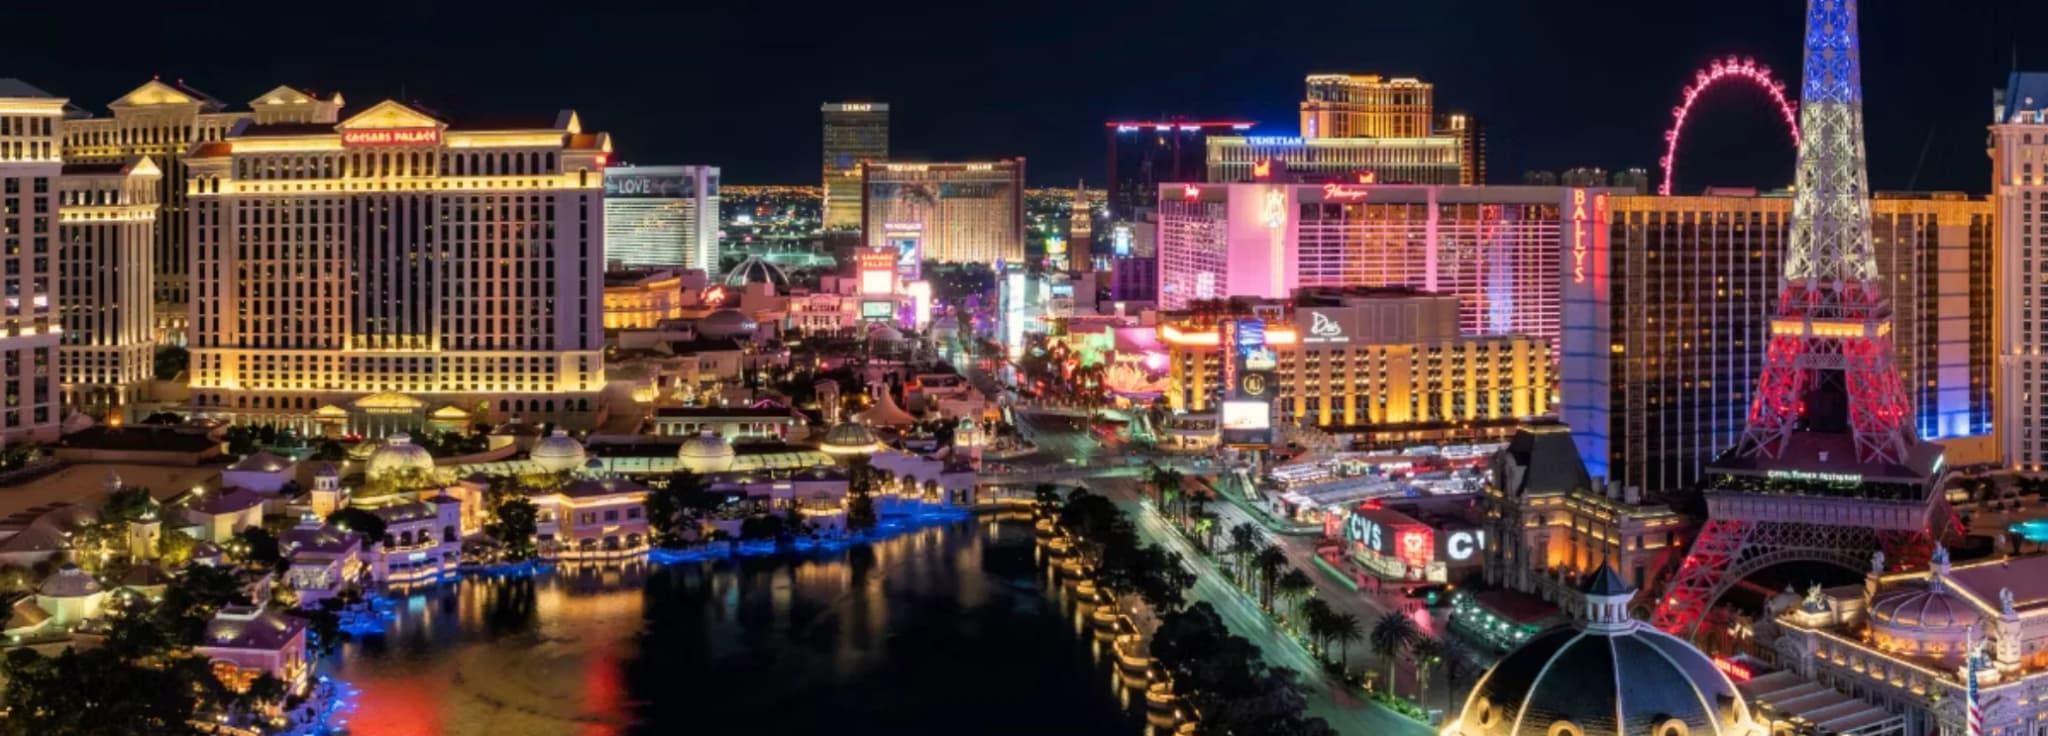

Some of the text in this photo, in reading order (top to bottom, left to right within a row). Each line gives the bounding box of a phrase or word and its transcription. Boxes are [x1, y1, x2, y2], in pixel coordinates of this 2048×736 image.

[345, 131, 436, 142] CAESARS PALACE
[1248, 136, 1303, 145] VENETIAN
[619, 178, 651, 194] LOVE
[1323, 184, 1368, 200] Flamingo
[1351, 512, 1382, 551] CVS
